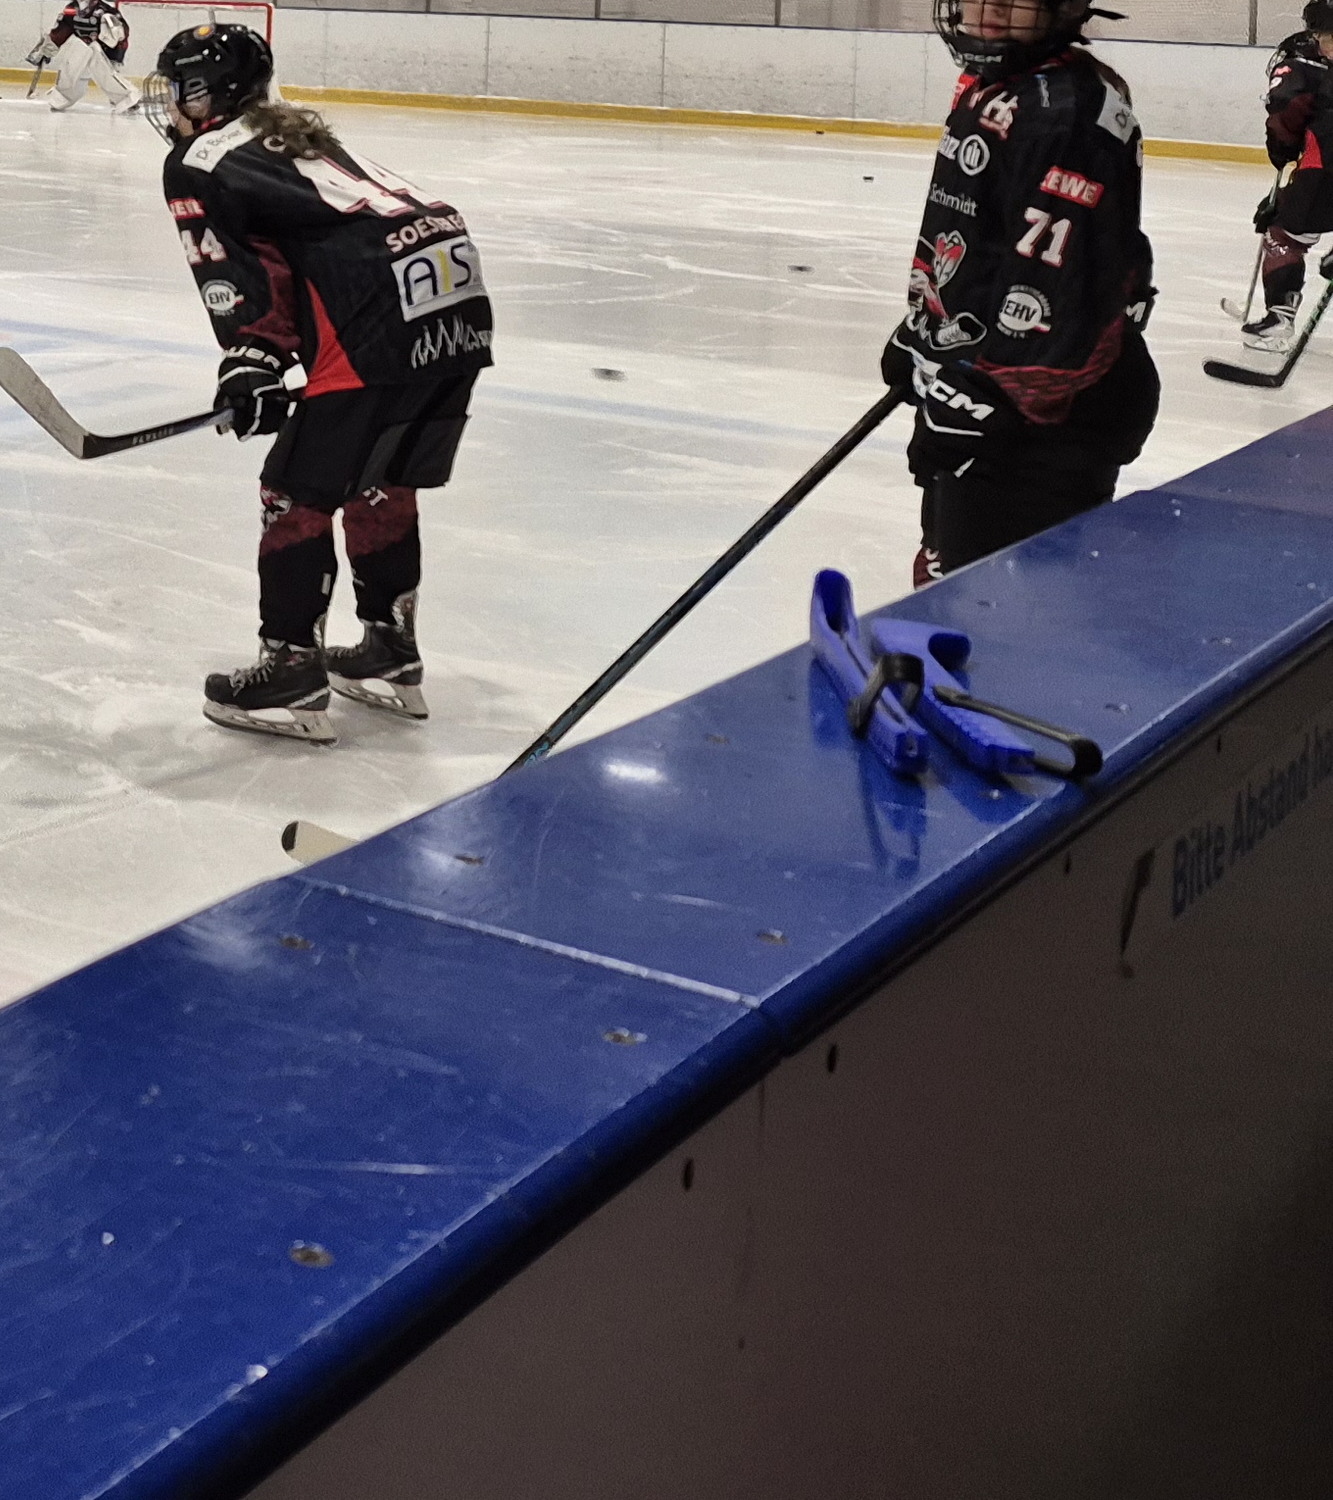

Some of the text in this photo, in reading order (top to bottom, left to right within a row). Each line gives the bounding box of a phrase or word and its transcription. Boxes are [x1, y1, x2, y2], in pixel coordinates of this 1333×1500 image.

[1015, 207, 1072, 268] 71
[403, 242, 472, 307] AIS
[1003, 302, 1039, 323] EHV
[928, 379, 995, 422] CM
[1171, 819, 1226, 920] Bitte
